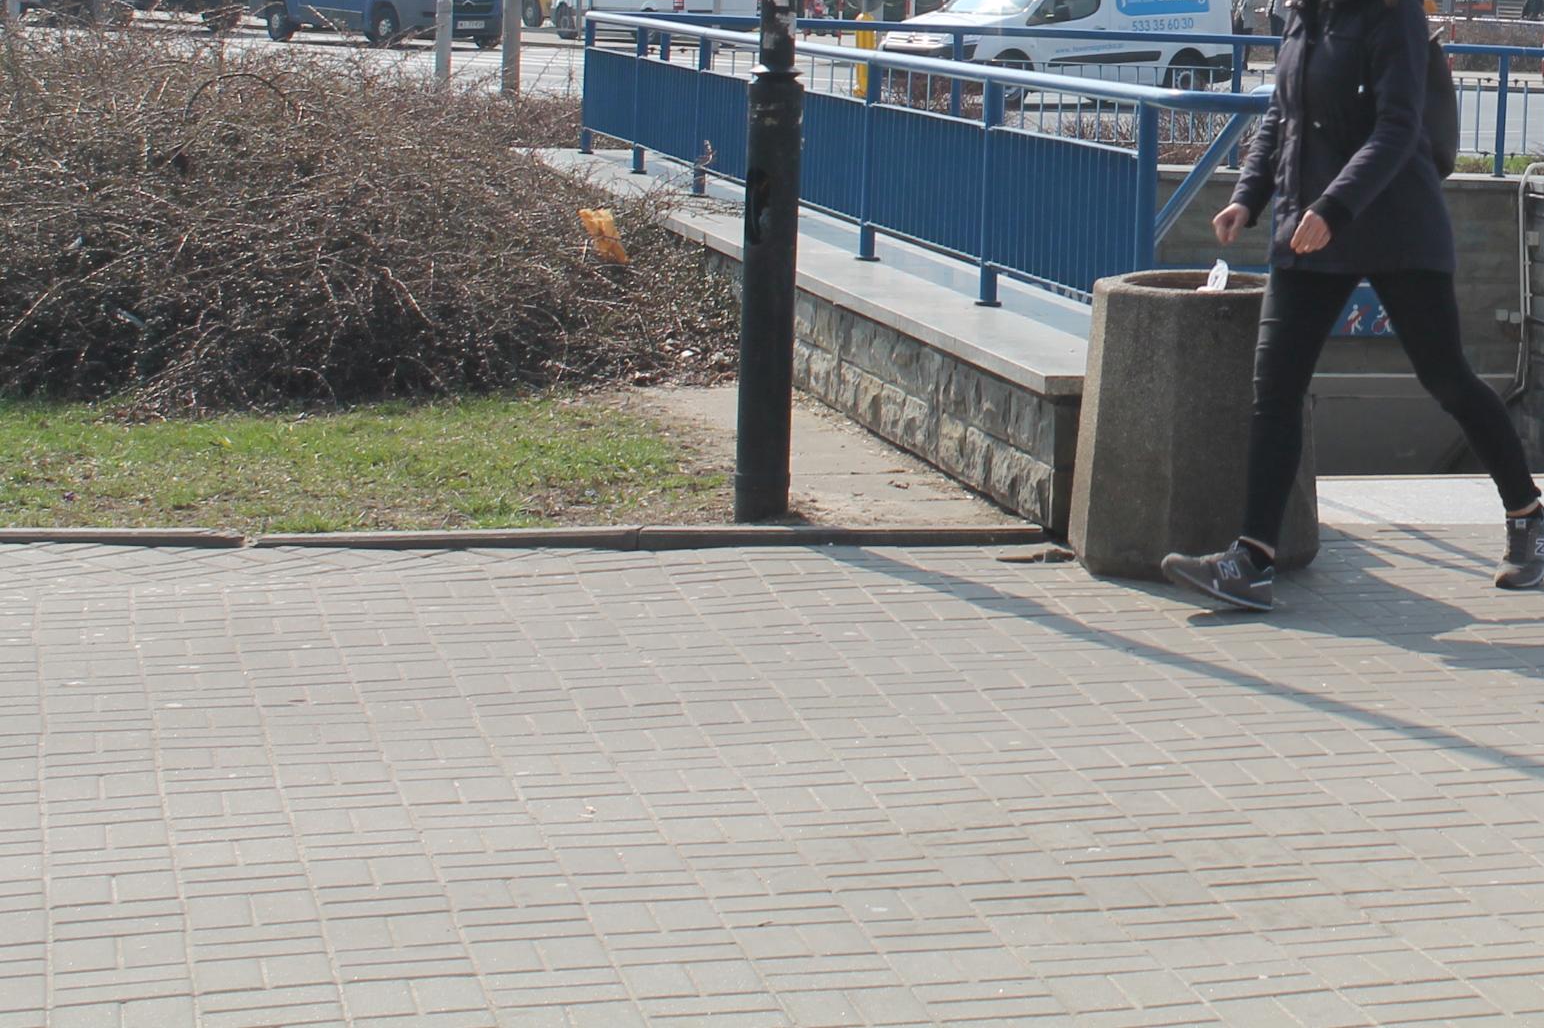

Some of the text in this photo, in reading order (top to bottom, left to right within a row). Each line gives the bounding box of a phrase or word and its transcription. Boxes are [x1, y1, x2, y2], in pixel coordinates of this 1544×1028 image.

[1132, 18, 1194, 31] 533 35 60 30
